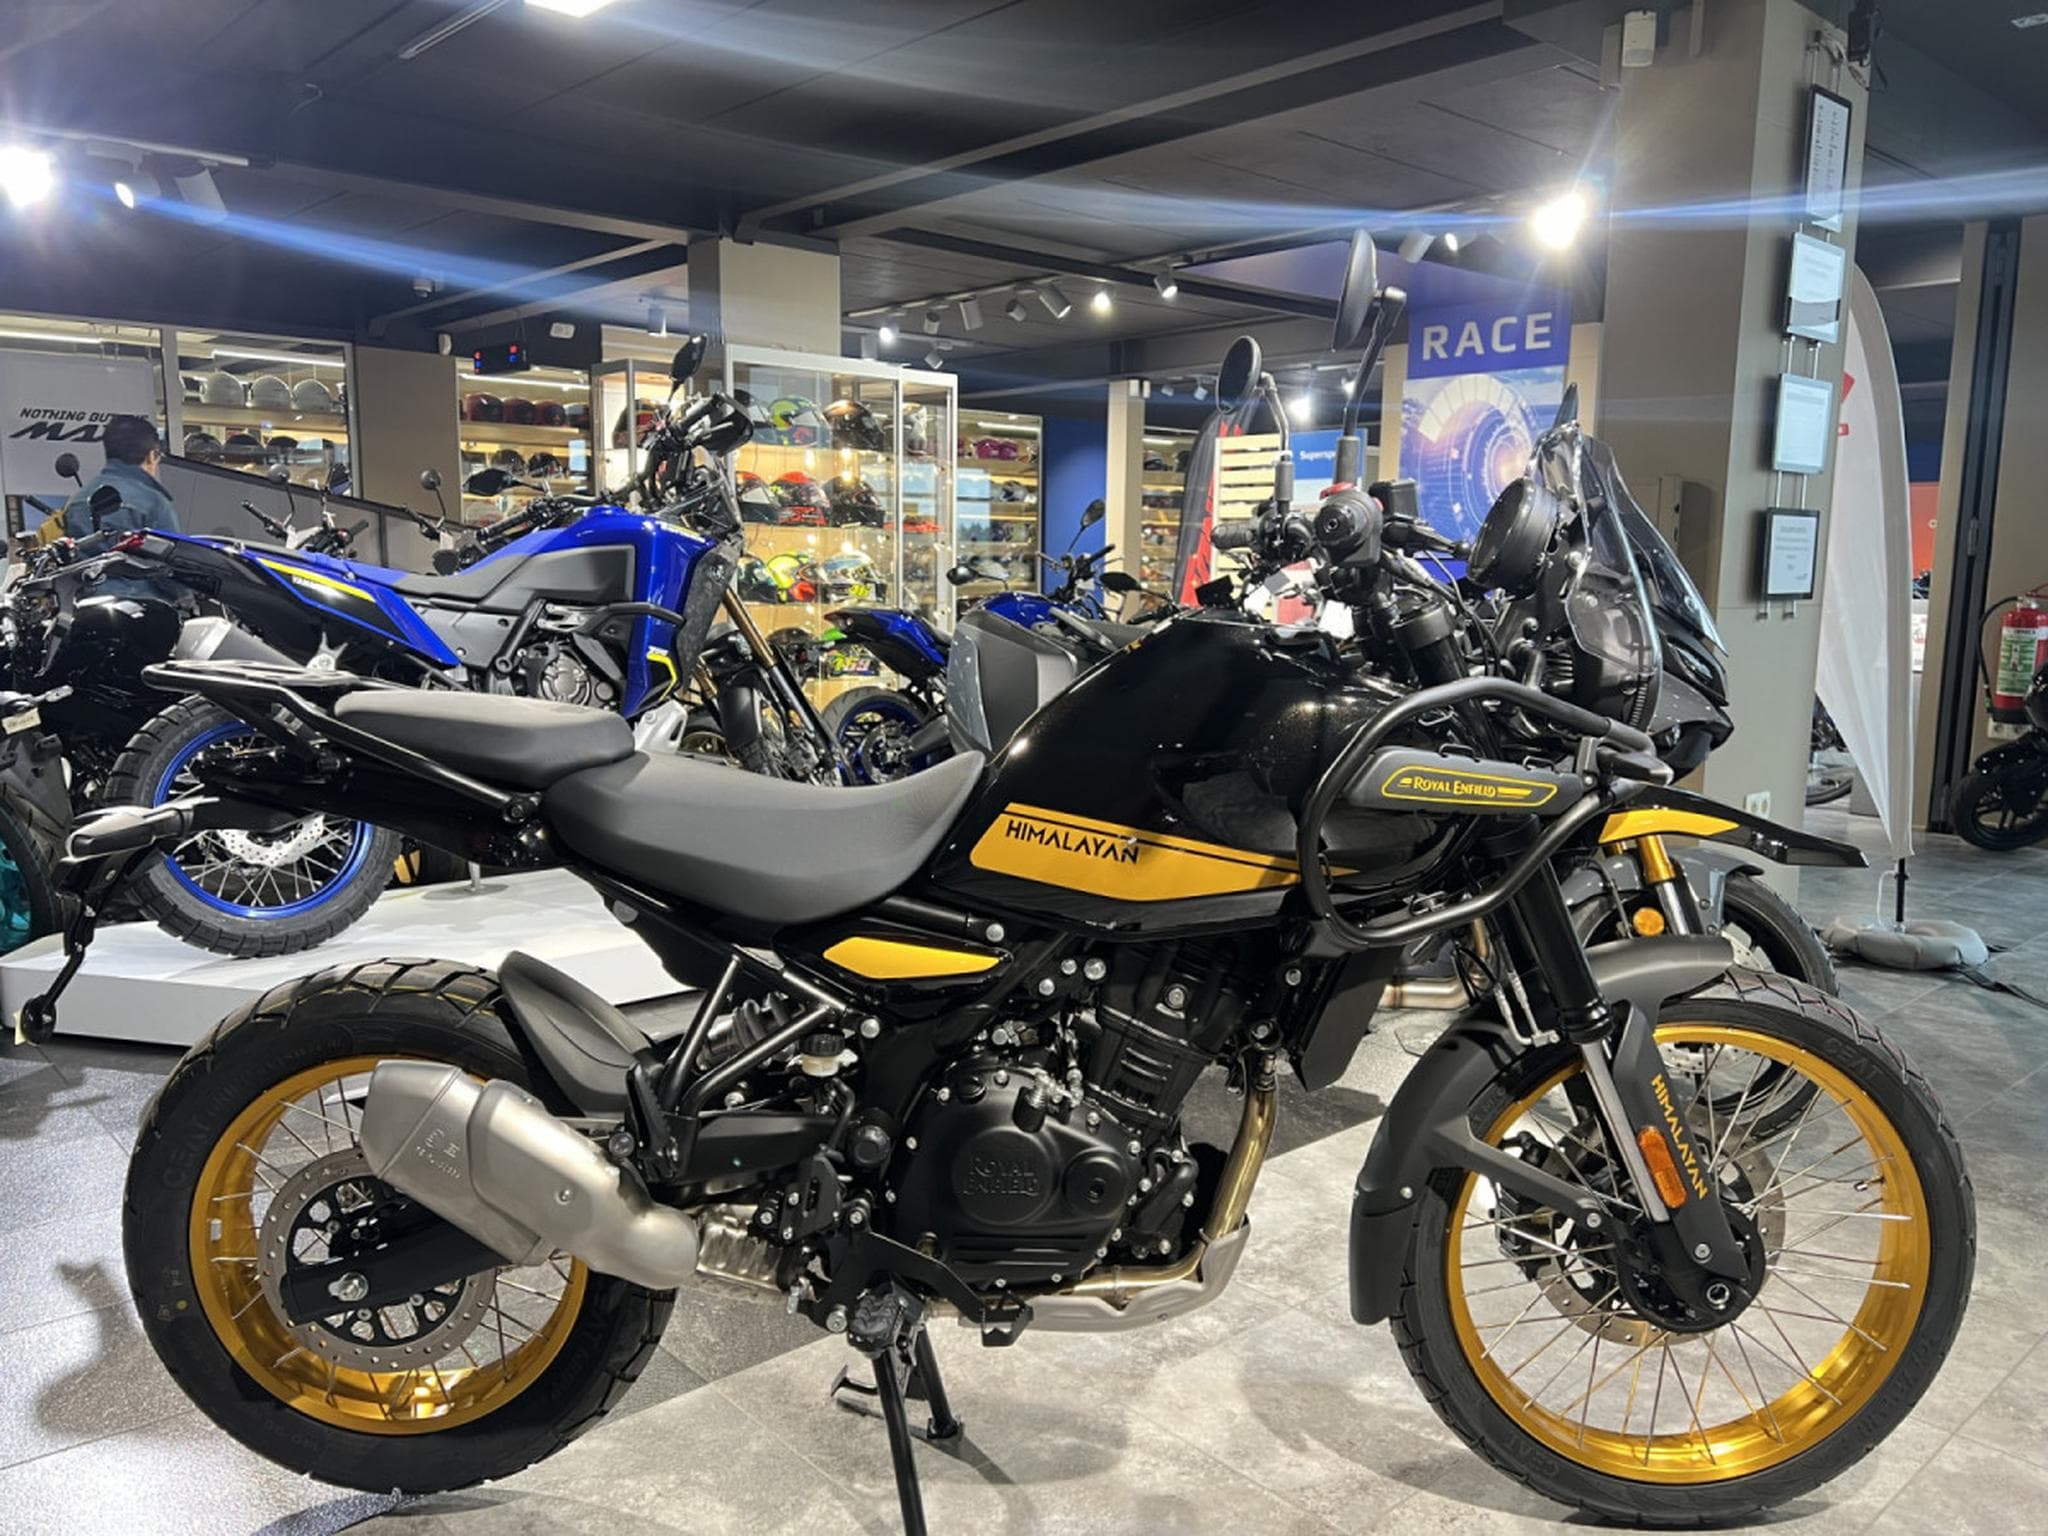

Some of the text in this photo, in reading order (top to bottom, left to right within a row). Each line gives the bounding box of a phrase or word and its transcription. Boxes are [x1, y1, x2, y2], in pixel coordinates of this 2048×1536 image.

[1422, 312, 1553, 361] RACE
[19, 407, 86, 422] NOTHING
[89, 412, 119, 423] BU
[8, 421, 107, 443] MA
[1413, 776, 1497, 798] ROYAL ENFIELD
[1006, 819, 1139, 864] HIMALAYAN
[1651, 1073, 1708, 1199] HIMALAYAN
